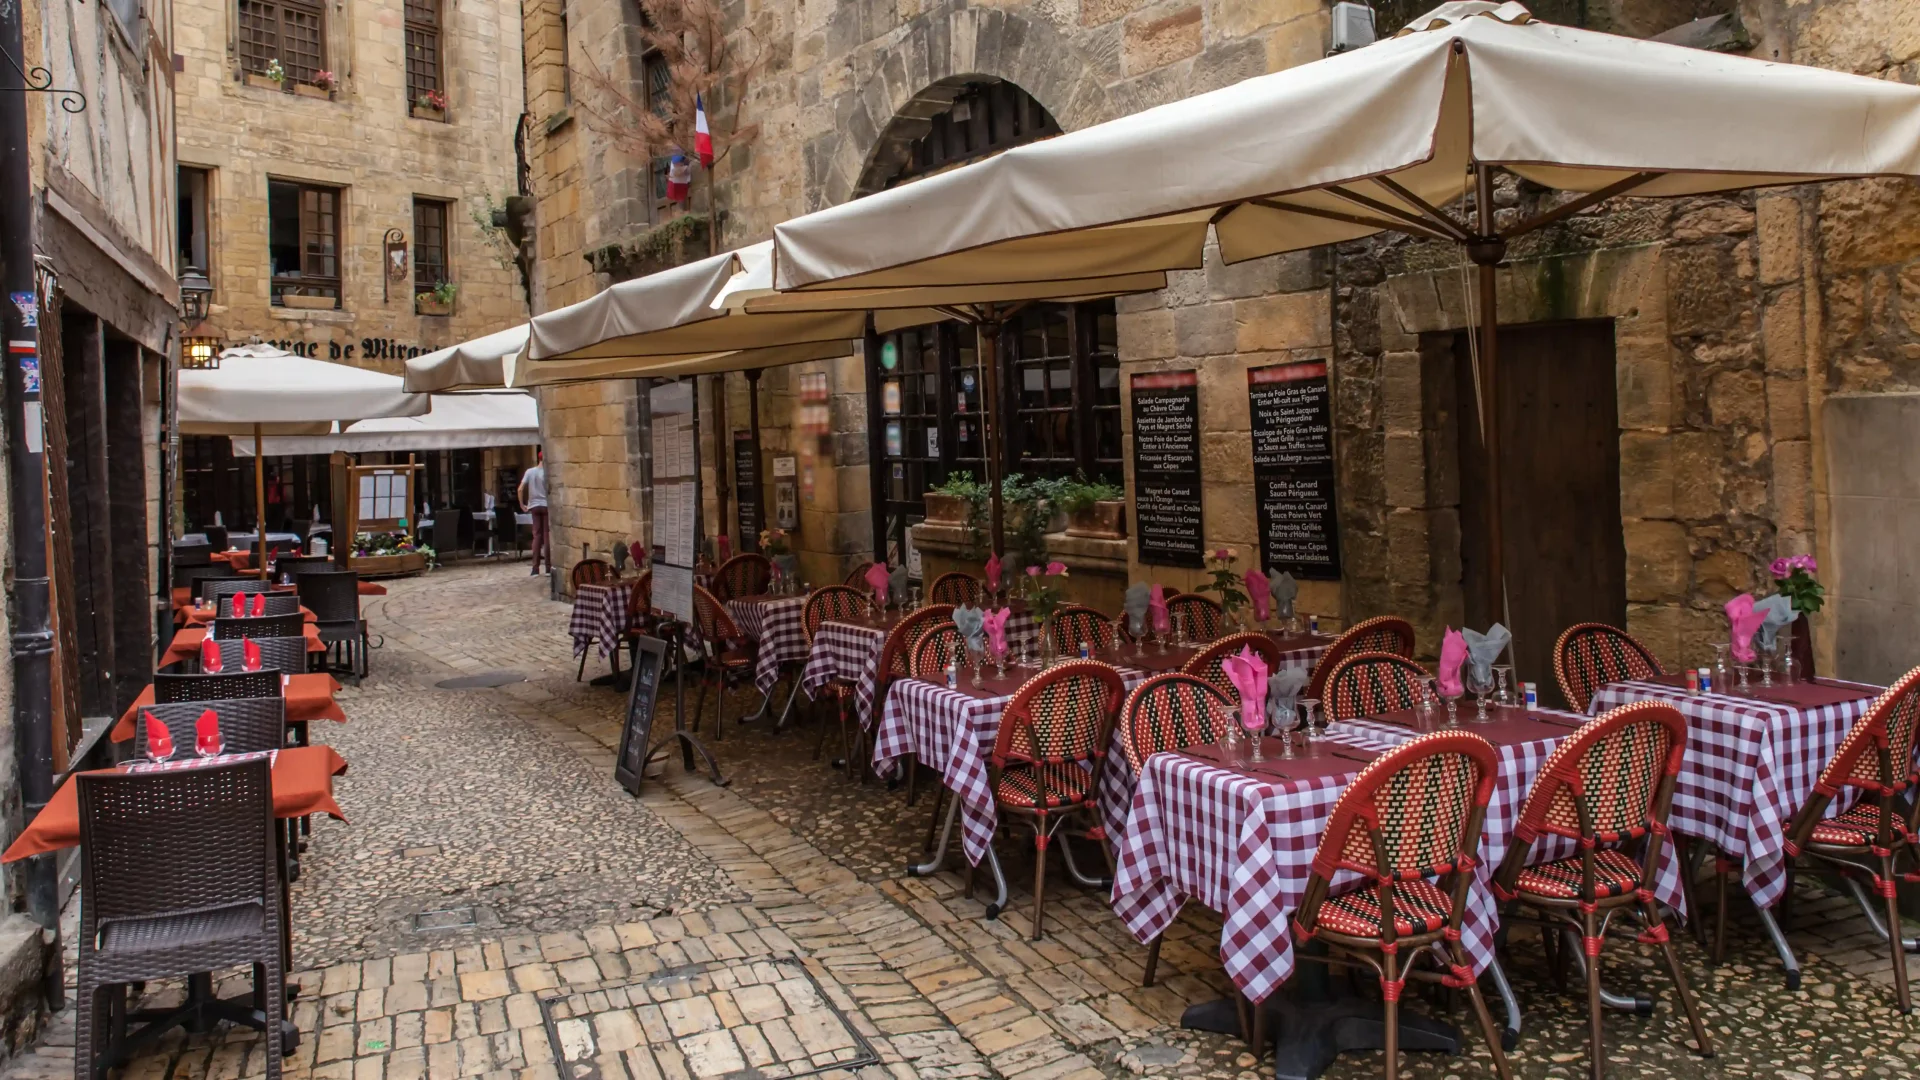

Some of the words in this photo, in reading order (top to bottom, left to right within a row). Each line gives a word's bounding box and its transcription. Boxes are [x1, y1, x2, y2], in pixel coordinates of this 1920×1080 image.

[329, 339, 354, 360] de
[1155, 396, 1189, 404] Campagnarde
[1276, 415, 1312, 424] Périgourdine
[1296, 480, 1317, 488] Canard
[1288, 490, 1318, 498] Périgueux
[1264, 503, 1297, 511] Aiguillettes
[1146, 539, 1166, 547] Pommes
[1270, 542, 1297, 550] Omelette
[1296, 553, 1329, 561] Sarladaises
